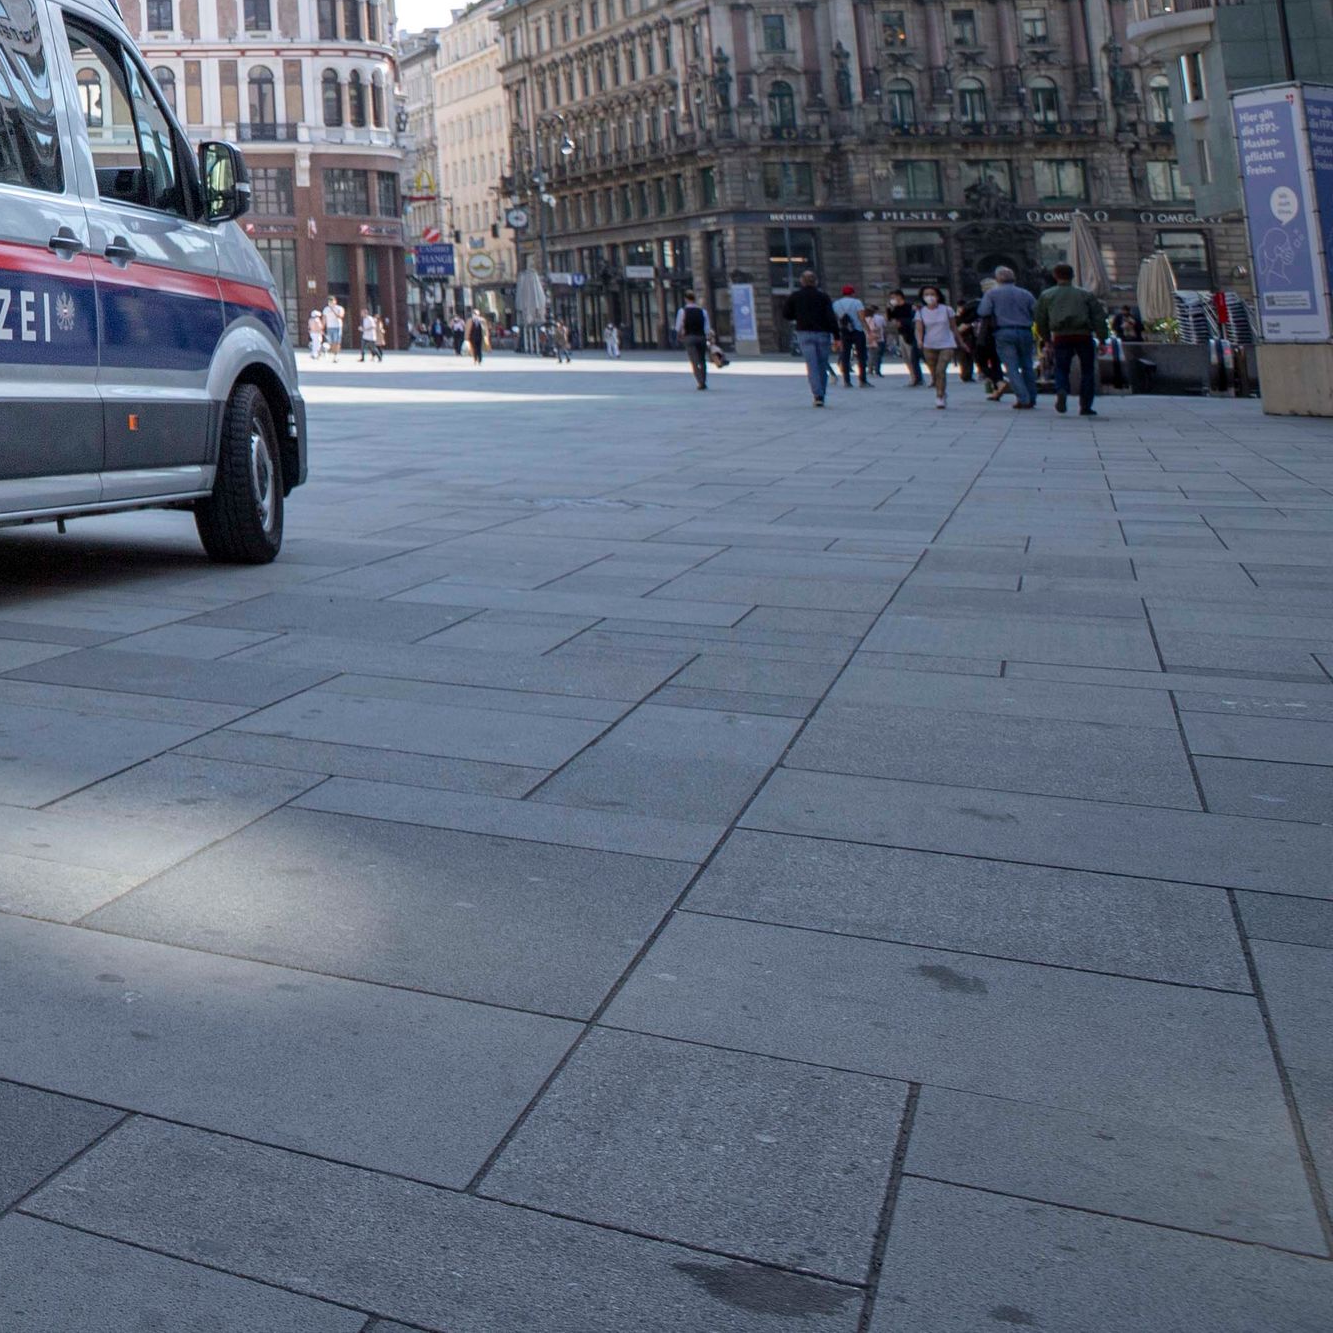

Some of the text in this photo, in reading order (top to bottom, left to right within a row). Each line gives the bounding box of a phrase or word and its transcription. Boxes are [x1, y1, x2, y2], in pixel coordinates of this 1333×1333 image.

[1239, 110, 1274, 123] Hier gilt
[1273, 149, 1286, 160] im
